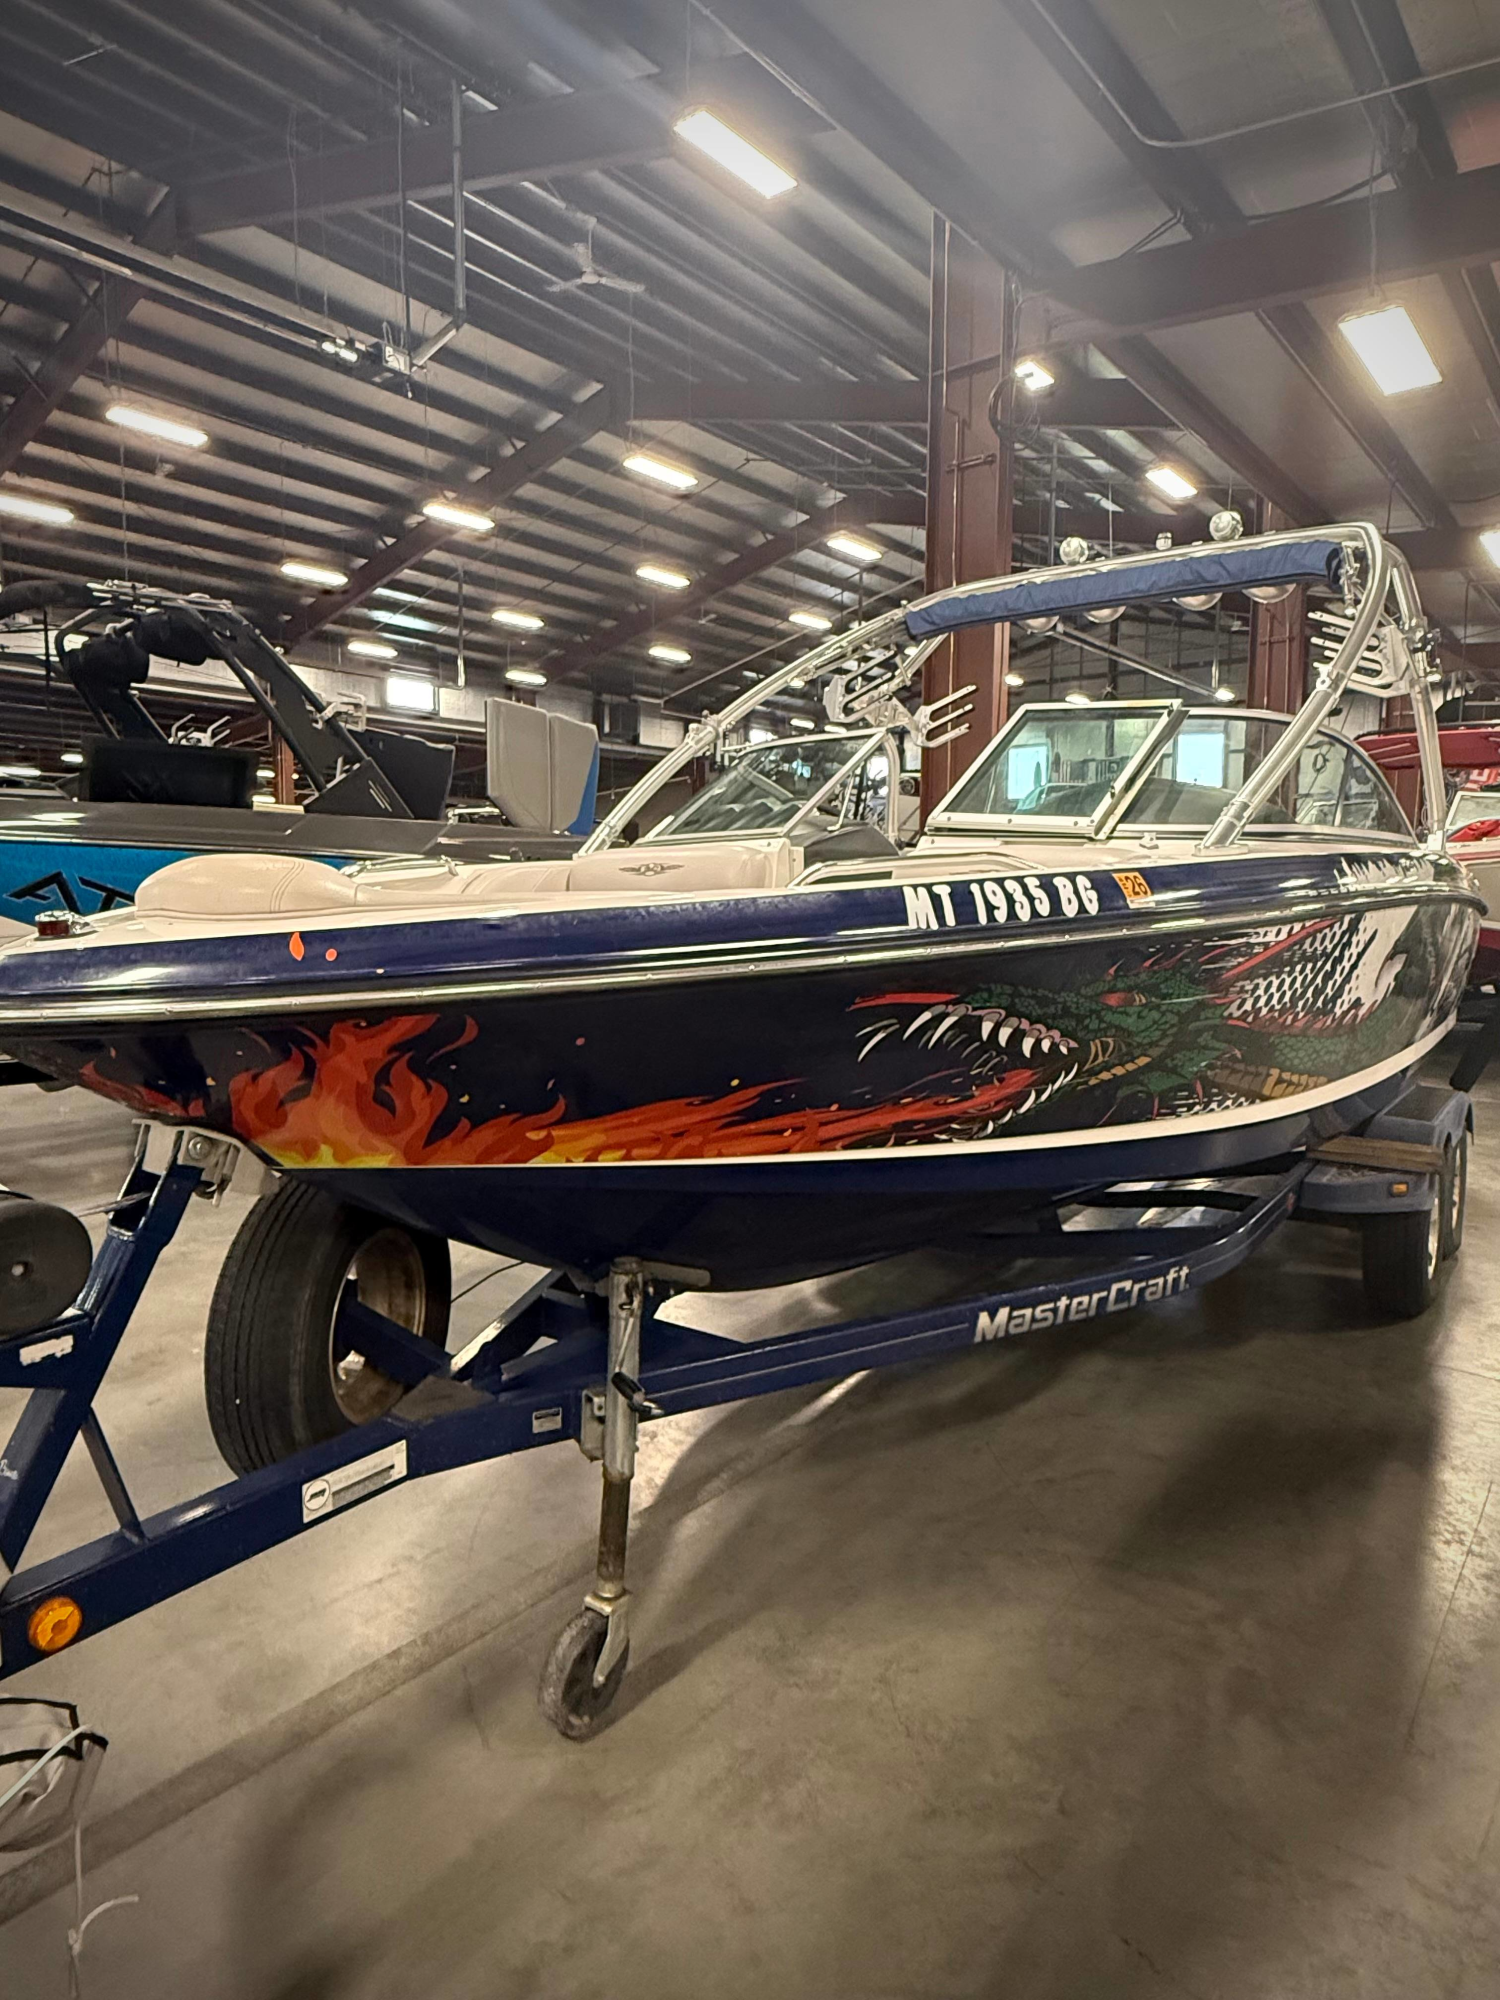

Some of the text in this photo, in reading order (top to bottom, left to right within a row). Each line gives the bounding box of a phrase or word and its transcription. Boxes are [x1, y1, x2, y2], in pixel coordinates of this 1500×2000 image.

[902, 884, 957, 930] MT
[970, 876, 1051, 926] 1935
[1053, 874, 1099, 918] BG
[1124, 875, 1149, 897] 26
[973, 1265, 1191, 1344] MasterCraft
